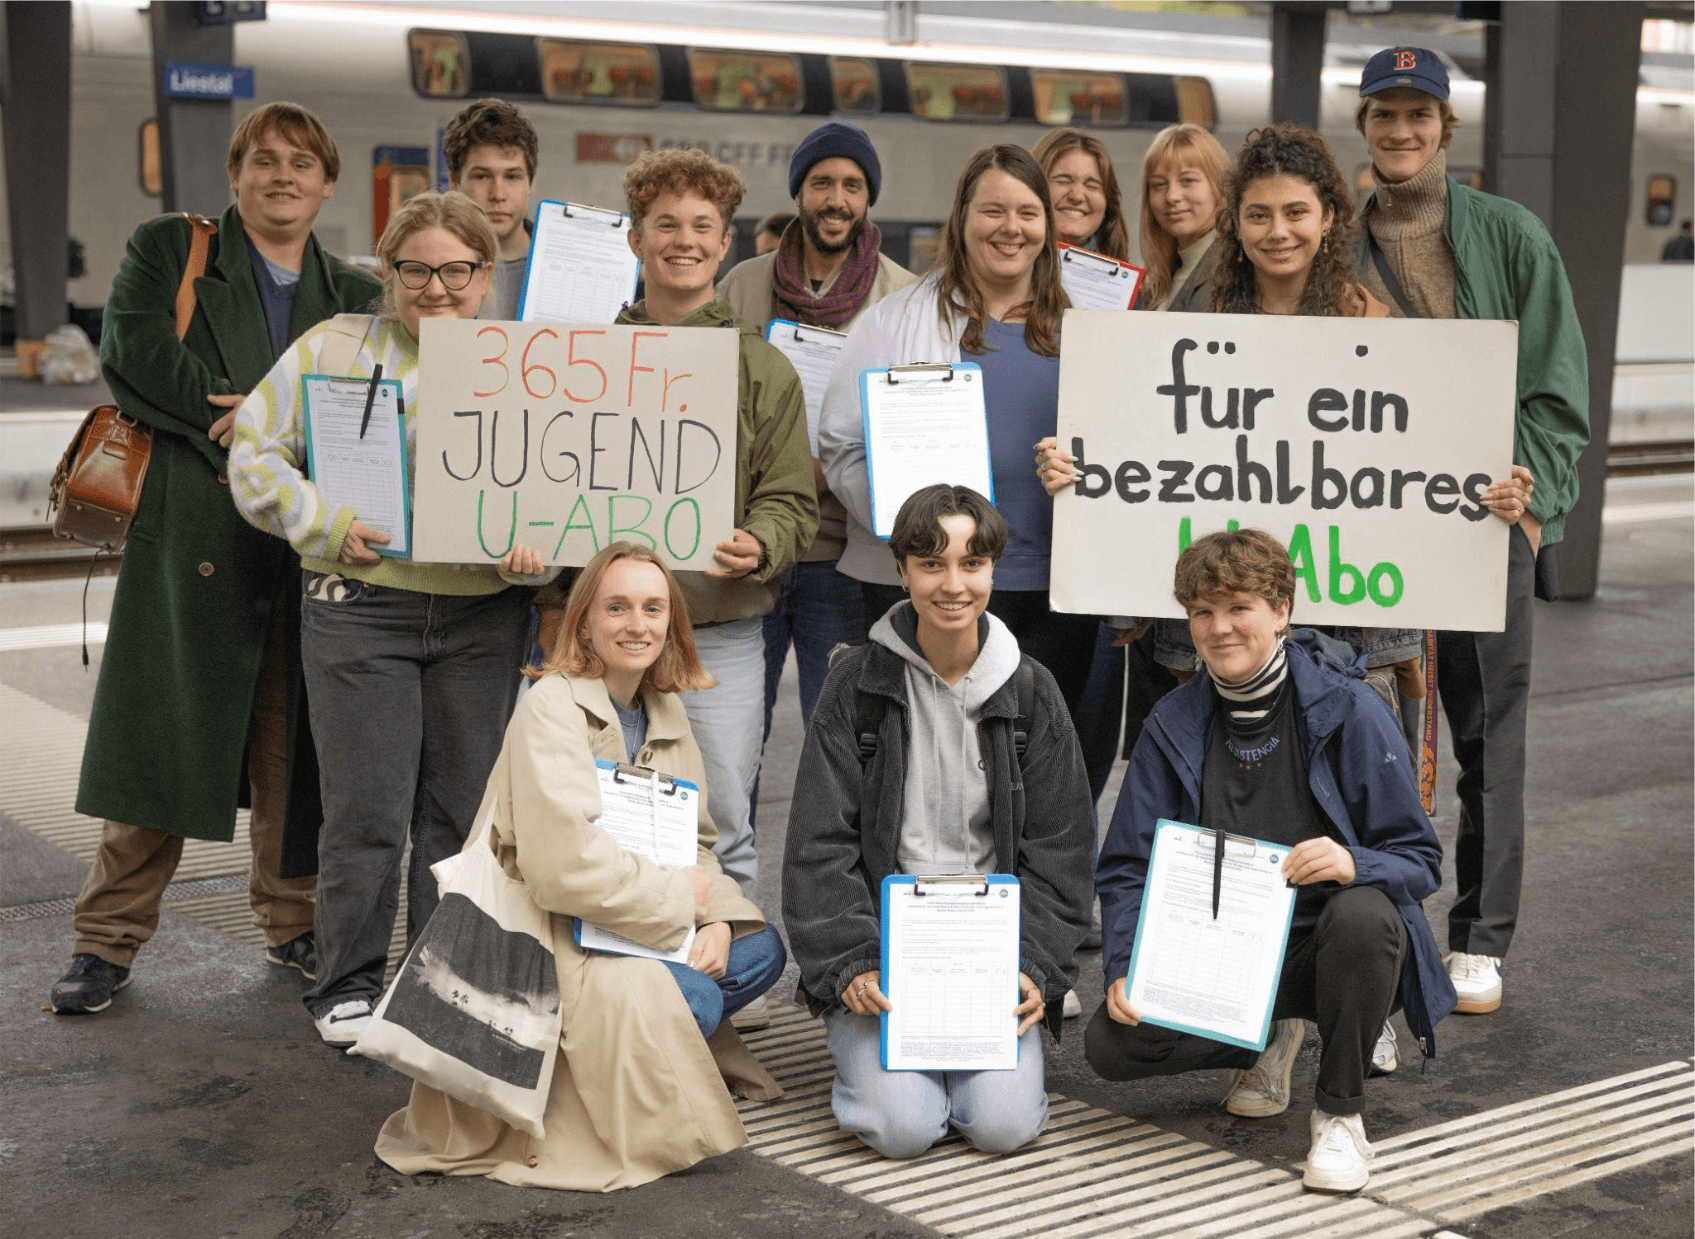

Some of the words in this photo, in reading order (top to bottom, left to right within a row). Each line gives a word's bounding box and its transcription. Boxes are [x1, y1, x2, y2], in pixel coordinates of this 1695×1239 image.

[170, 70, 233, 94] Liestal
[1393, 50, 1416, 70] B
[473, 326, 608, 403] 365
[627, 331, 693, 413] Fr.
[1156, 338, 1275, 434] für
[1307, 344, 1409, 433] ein
[442, 409, 721, 494] JUGEND
[1072, 434, 1493, 522] bezahlbares
[477, 490, 701, 561] U-ABO
[1179, 517, 1404, 608] Abo
